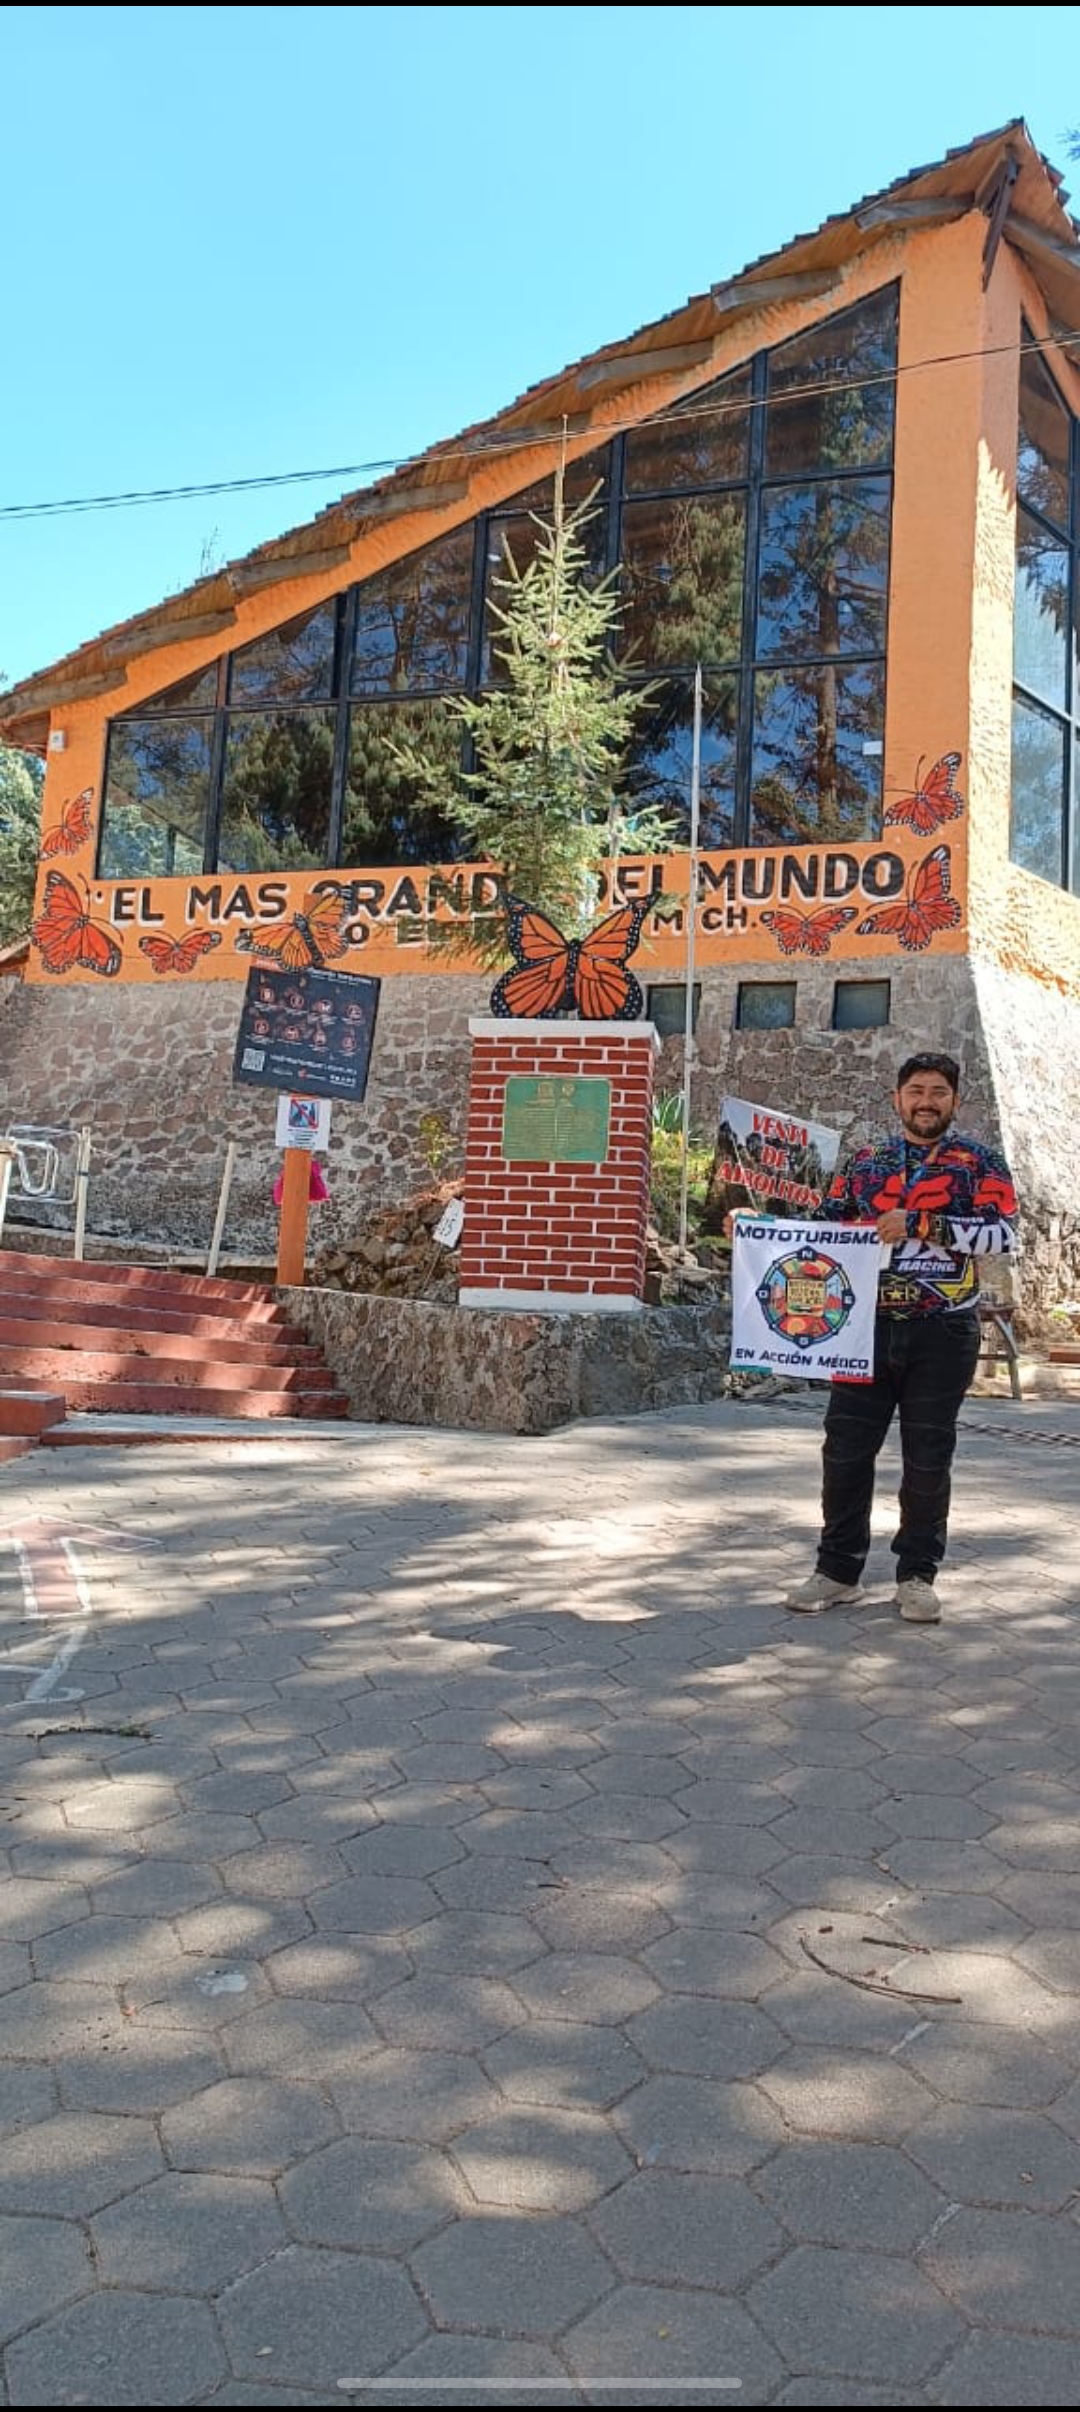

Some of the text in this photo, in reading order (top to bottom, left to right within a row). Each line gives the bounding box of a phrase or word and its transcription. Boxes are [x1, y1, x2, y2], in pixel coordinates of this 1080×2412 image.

[191, 882, 288, 921] MAS
[698, 849, 906, 904] MUNDO
[652, 905, 758, 934] MCH.
[752, 1112, 809, 1148] VENTA
[761, 1145, 787, 1169] DE
[735, 1224, 879, 1245] MOTOTURISMO
[897, 1260, 957, 1272] RACING
[734, 1347, 755, 1359] EN
[759, 1350, 812, 1366] ACCIÓN
